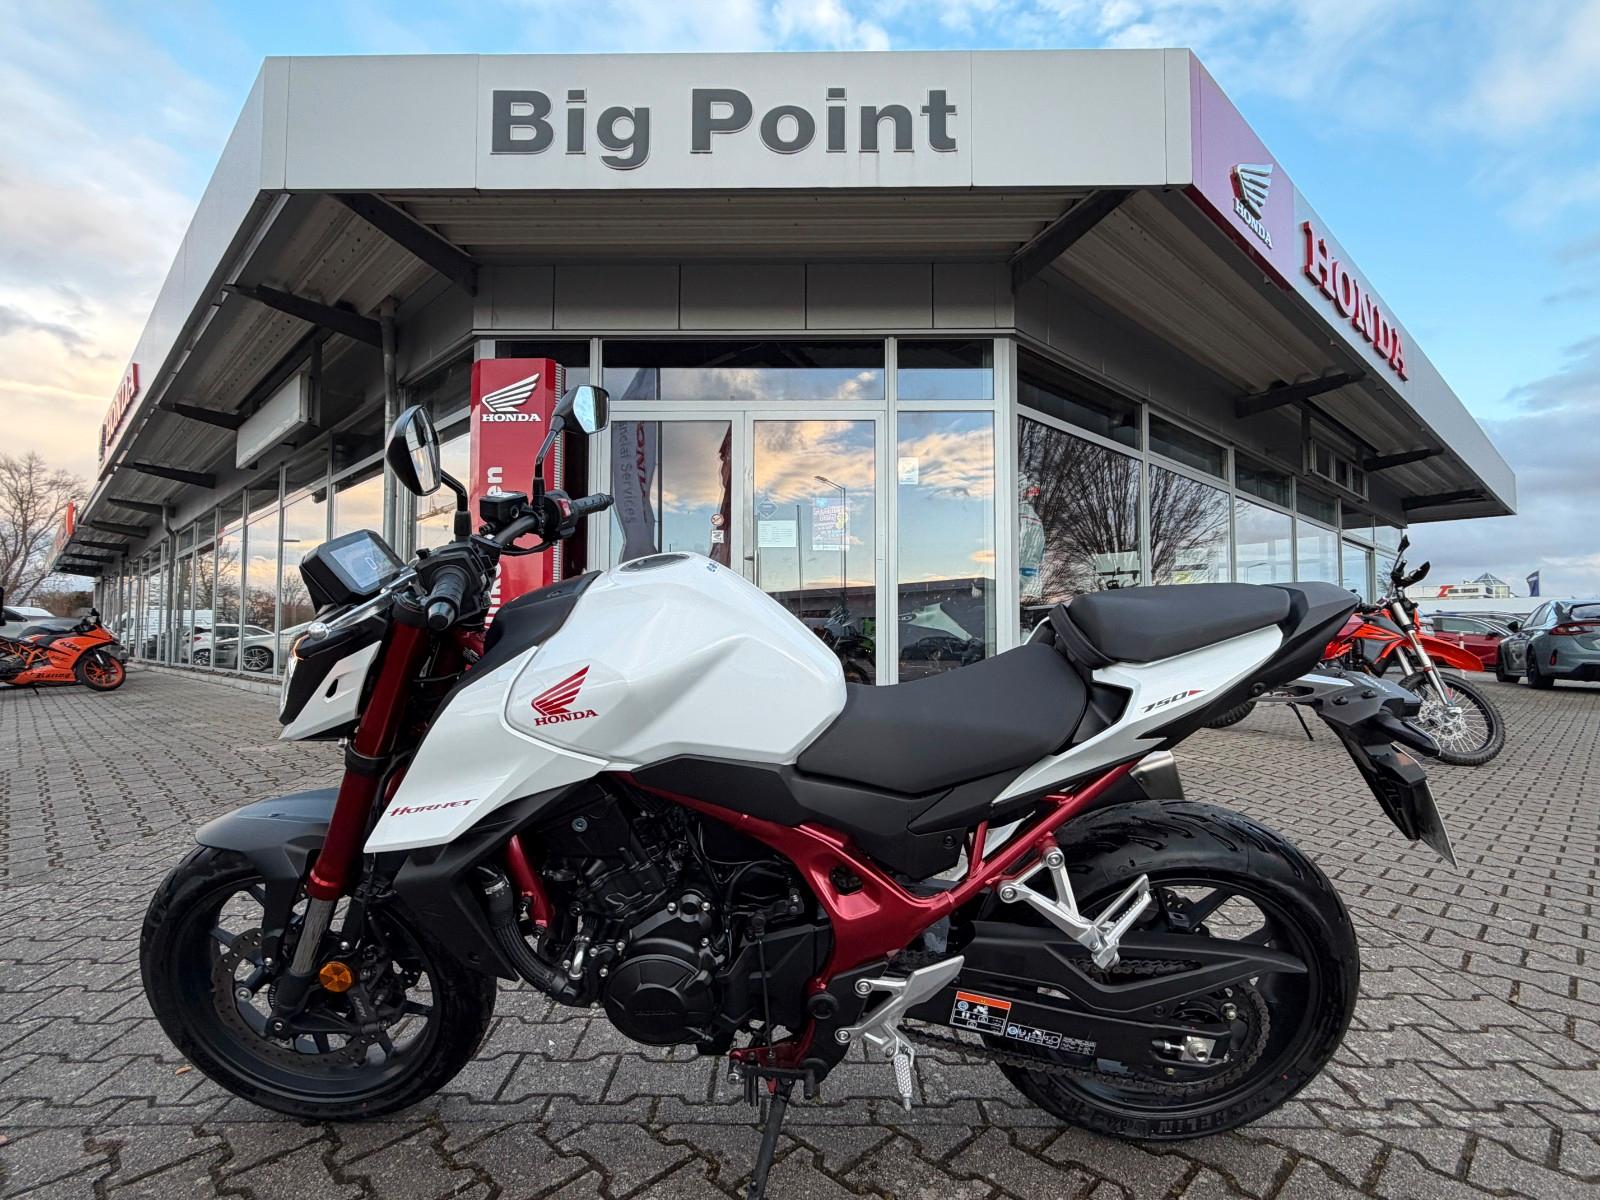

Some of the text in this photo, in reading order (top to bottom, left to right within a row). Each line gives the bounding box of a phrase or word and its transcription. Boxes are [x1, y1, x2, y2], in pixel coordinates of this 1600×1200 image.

[490, 87, 959, 171] Big Point
[1233, 198, 1273, 250] HONDA
[1302, 221, 1408, 381] HONDA
[481, 412, 542, 423] HONDA
[1141, 692, 1188, 713] 750
[534, 708, 600, 727] HONDA
[387, 799, 479, 817] HORNET
